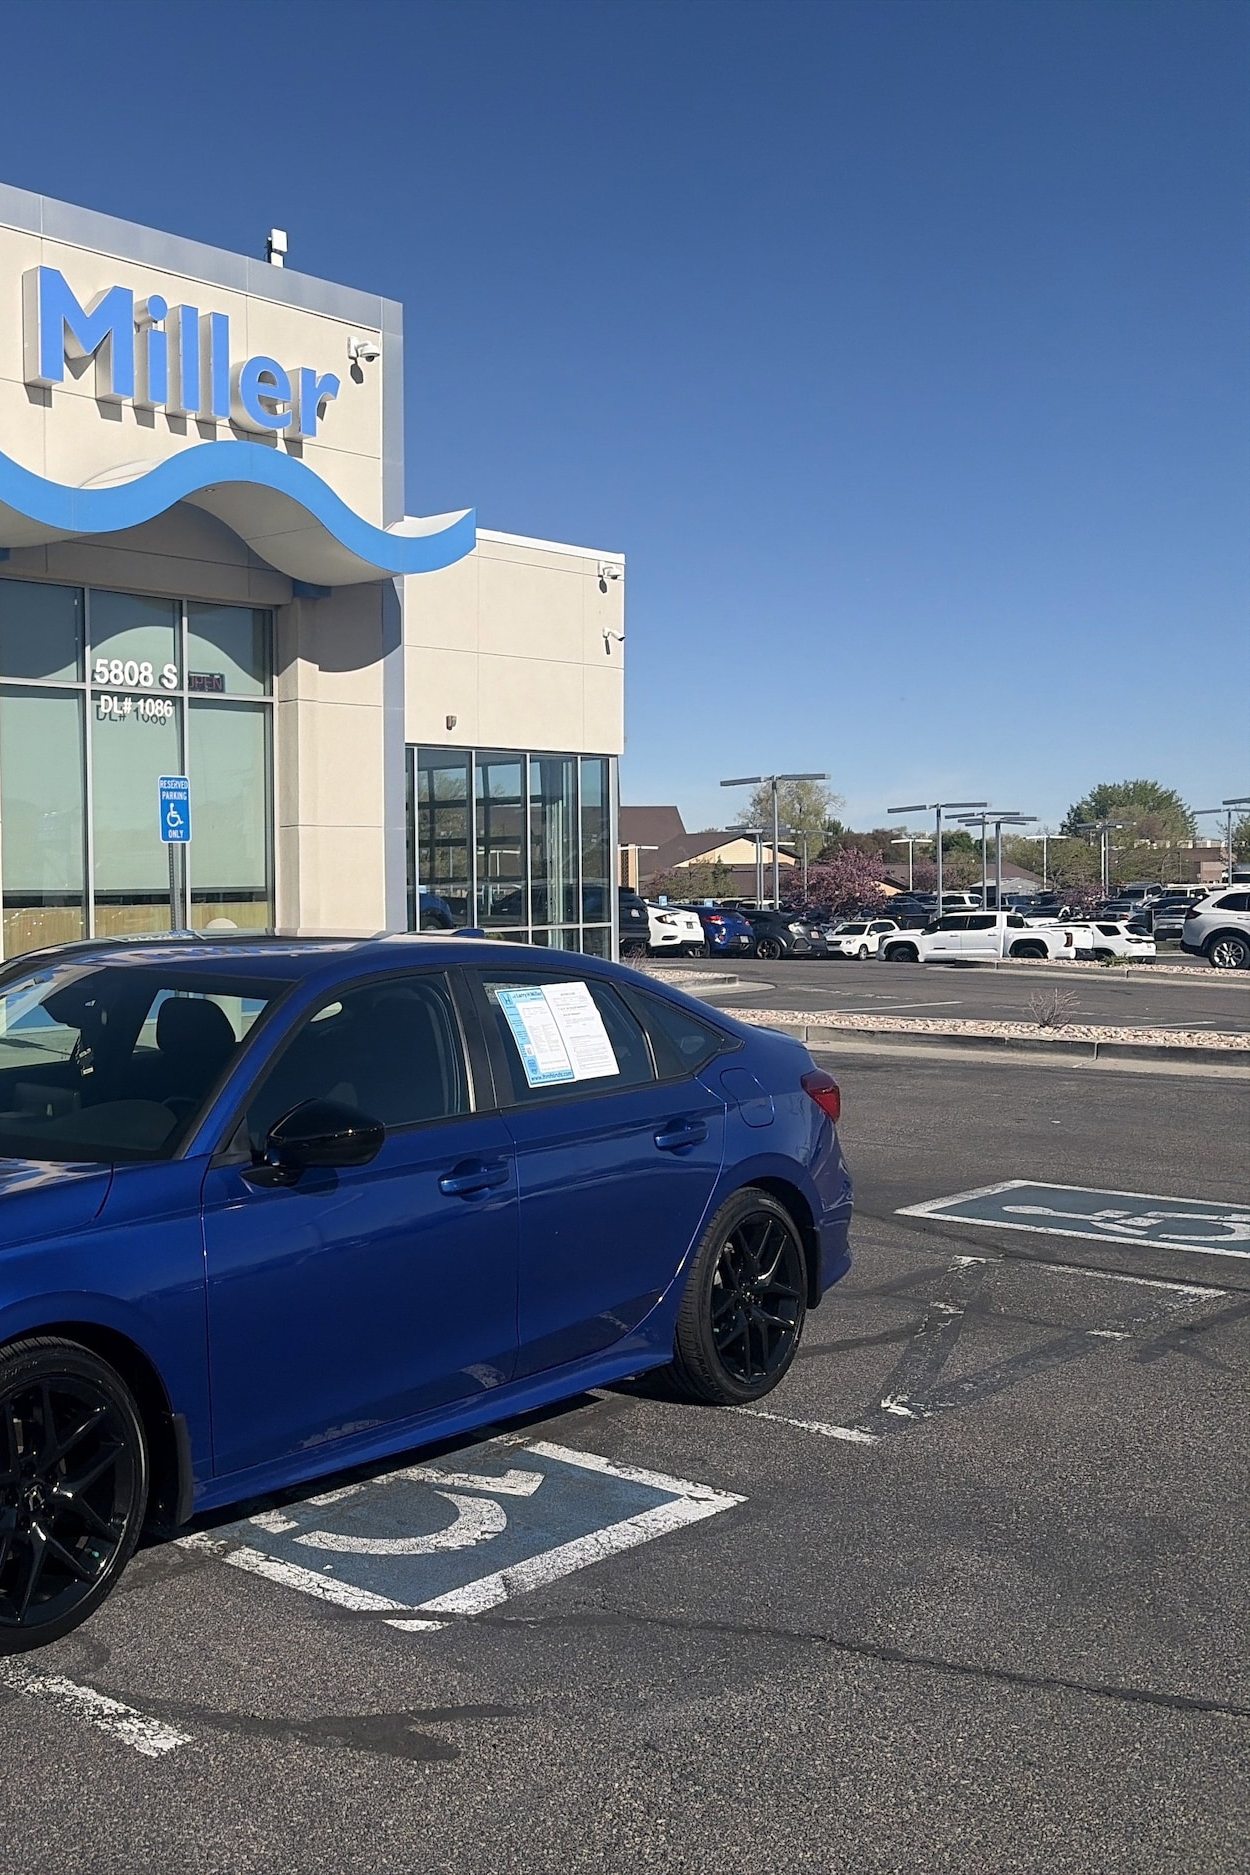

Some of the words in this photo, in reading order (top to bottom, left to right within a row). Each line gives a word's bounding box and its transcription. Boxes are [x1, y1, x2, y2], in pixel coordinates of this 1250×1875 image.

[25, 265, 341, 438] Miller
[94, 658, 154, 687] 5808
[161, 663, 178, 689] S
[100, 695, 132, 714] DL#
[137, 698, 173, 718] 1086
[160, 779, 188, 790] RESERVED
[161, 790, 187, 801] PARKING
[168, 829, 184, 839] ONLY
